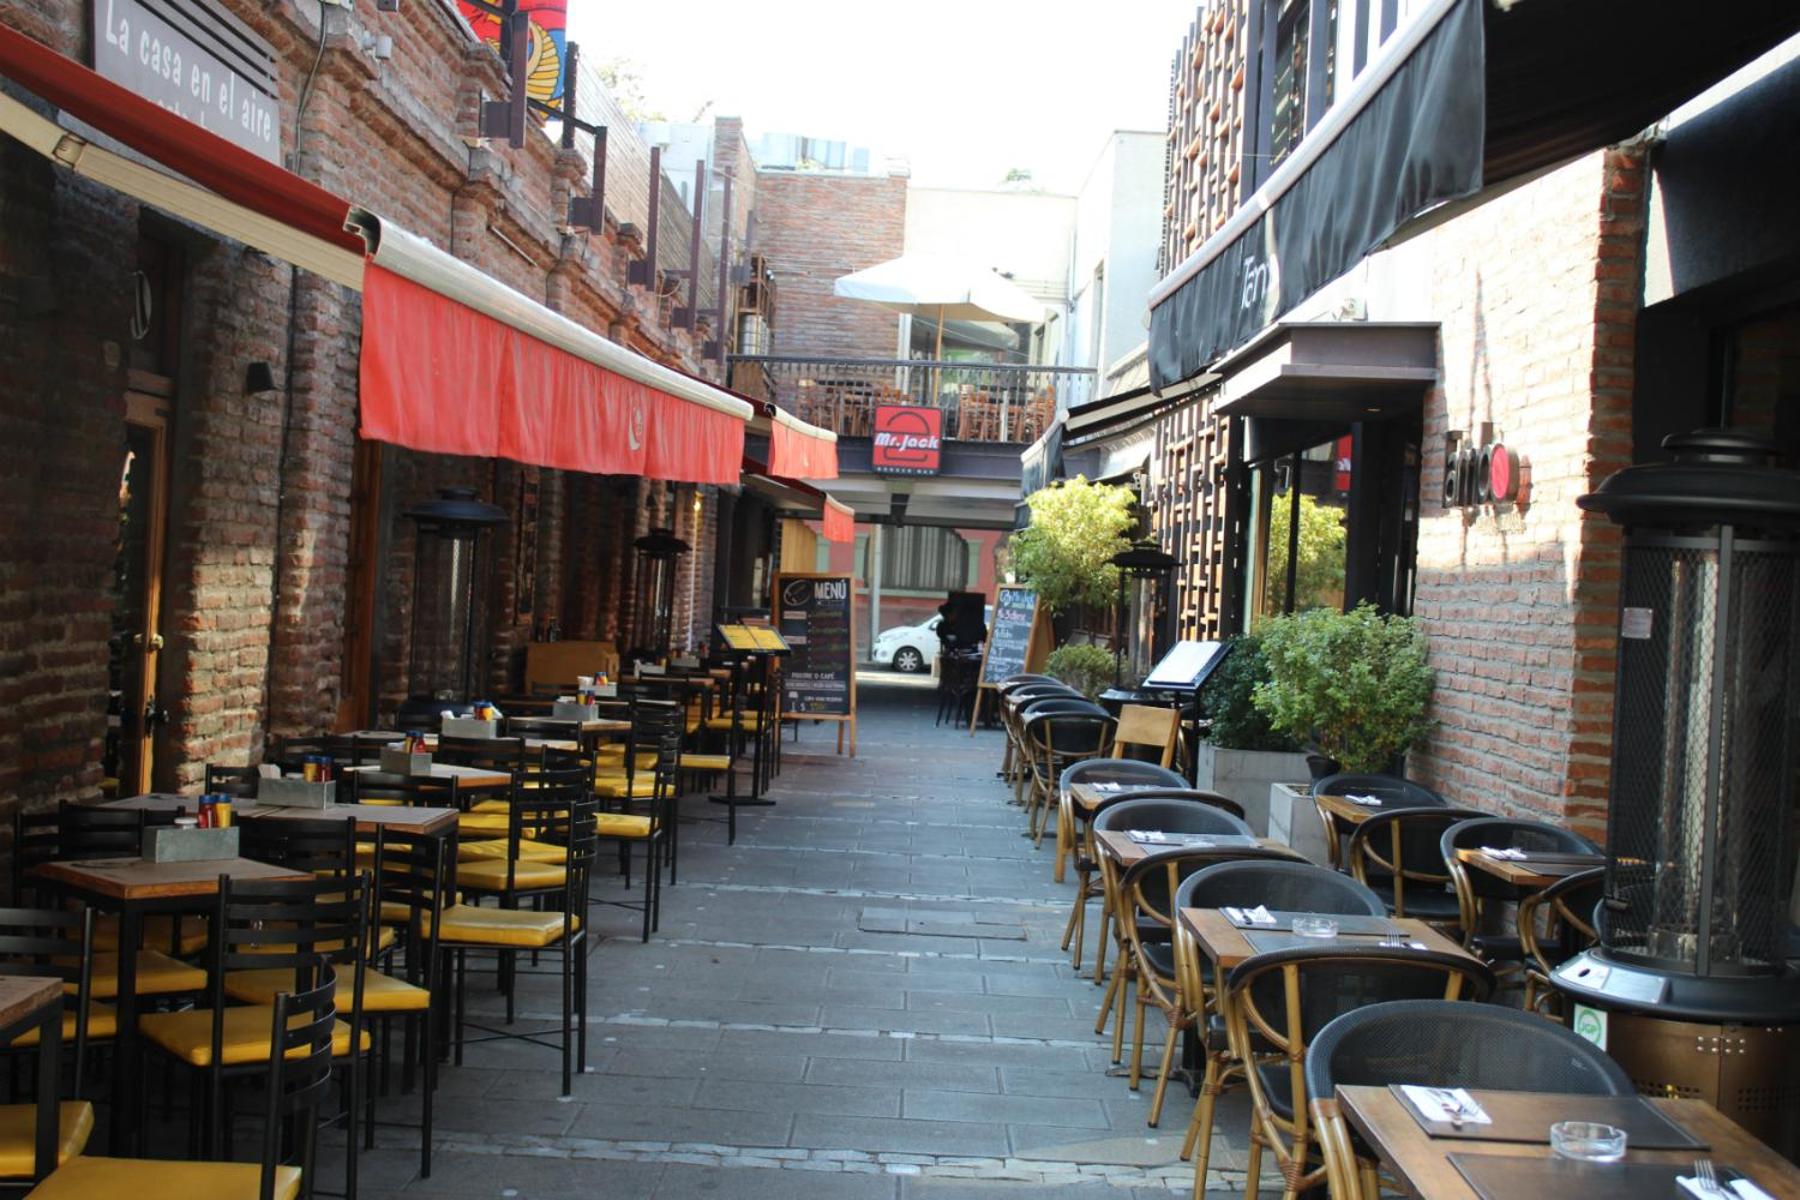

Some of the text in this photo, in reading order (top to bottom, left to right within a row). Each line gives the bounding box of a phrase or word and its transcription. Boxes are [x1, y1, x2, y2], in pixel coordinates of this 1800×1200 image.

[106, 0, 130, 56] La
[140, 29, 182, 88] casa
[191, 63, 211, 103] en
[219, 71, 235, 121] el
[241, 91, 272, 143] aire
[814, 579, 847, 600] MENÚ
